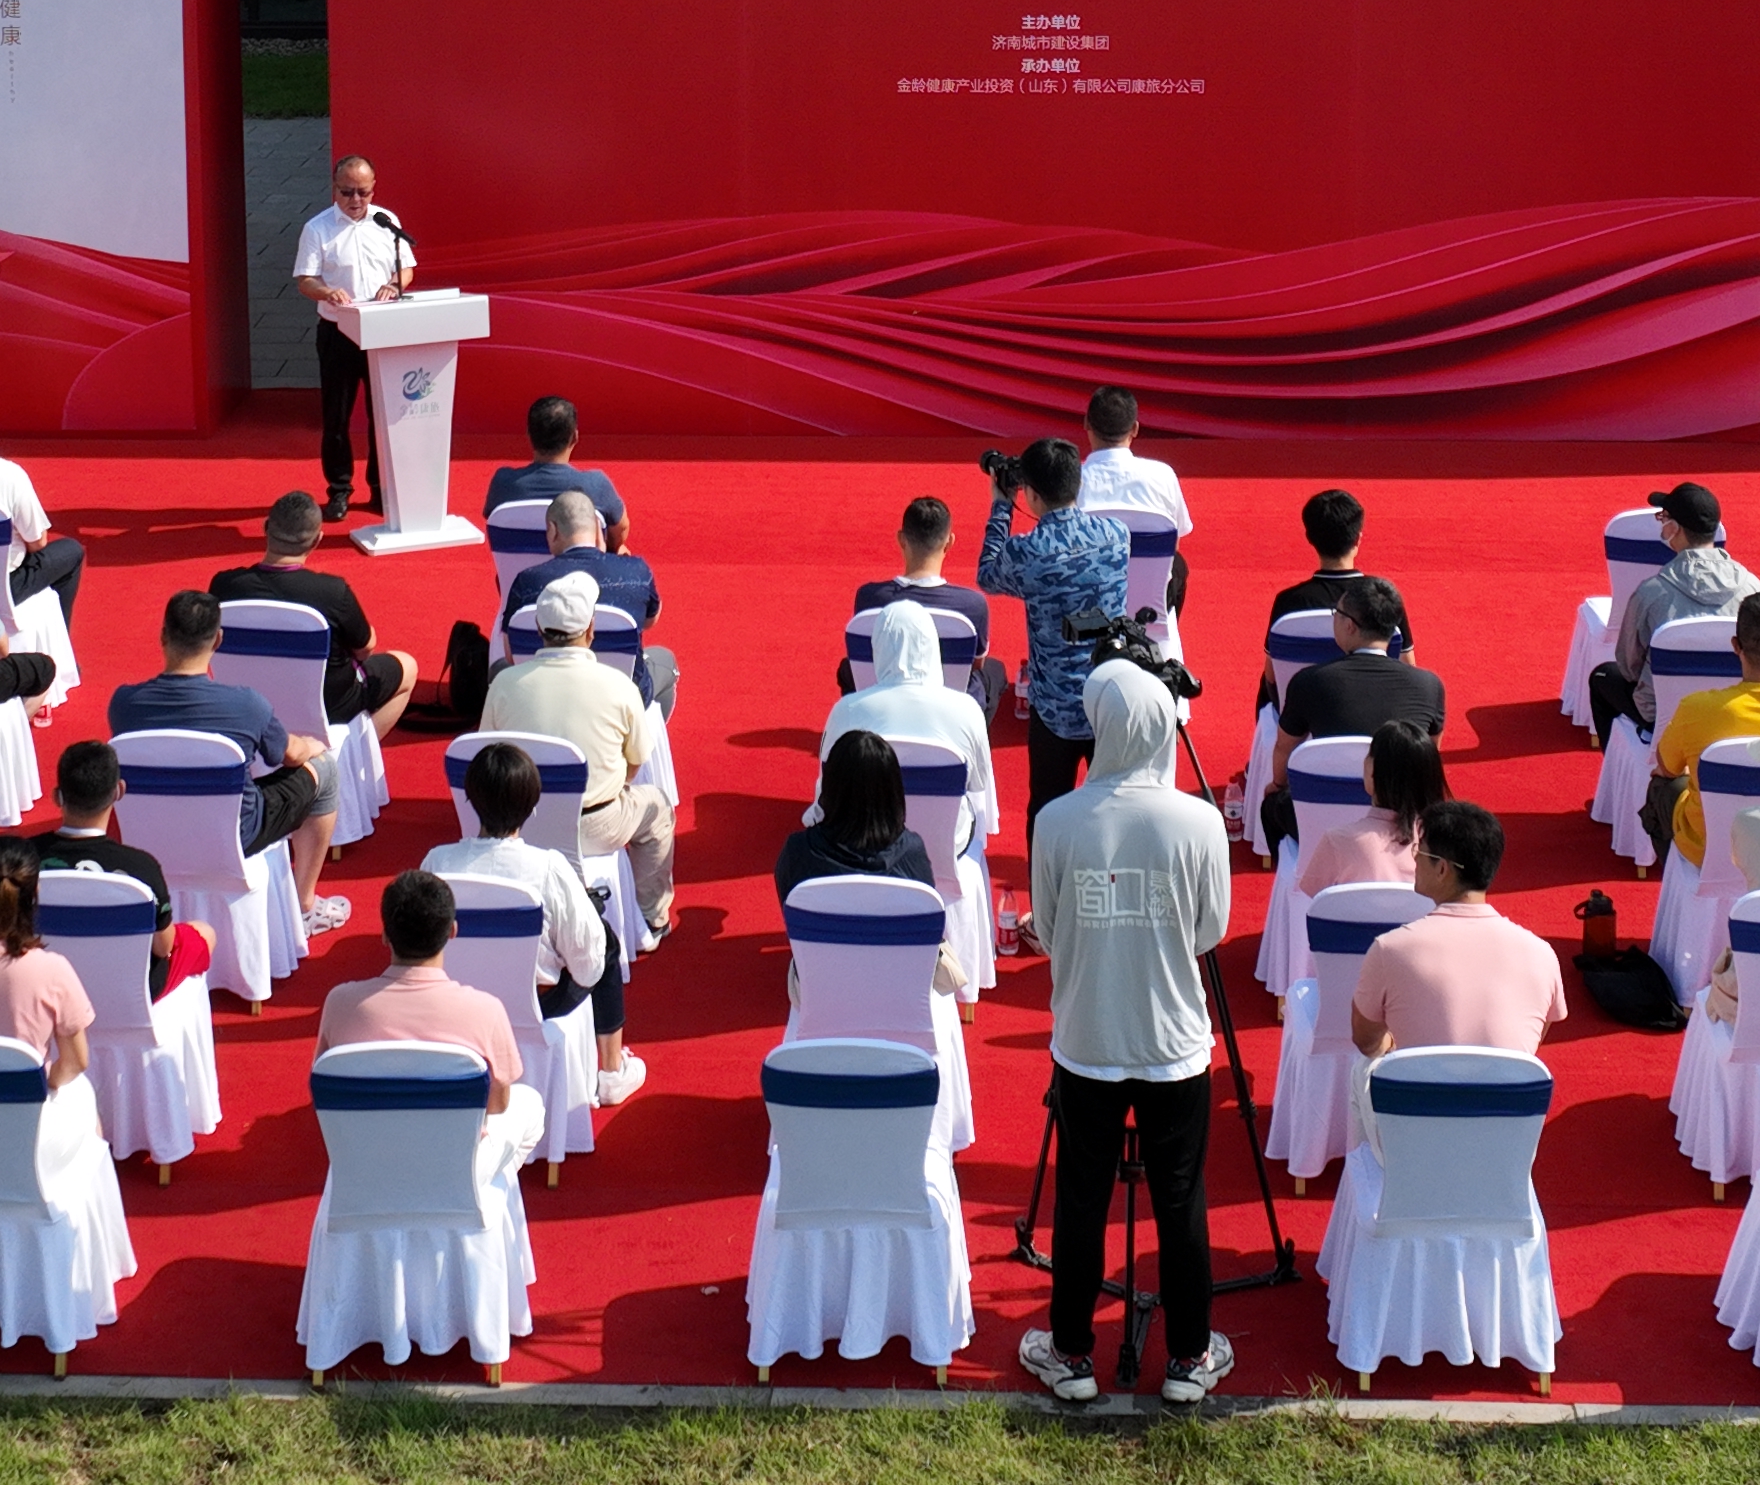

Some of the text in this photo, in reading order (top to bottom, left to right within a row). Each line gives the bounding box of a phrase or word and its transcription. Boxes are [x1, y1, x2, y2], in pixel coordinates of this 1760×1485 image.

[1021, 14, 1081, 30] 主办单位
[992, 35, 1110, 51] 济南城市建设集团
[1021, 57, 1081, 74] 承办单位
